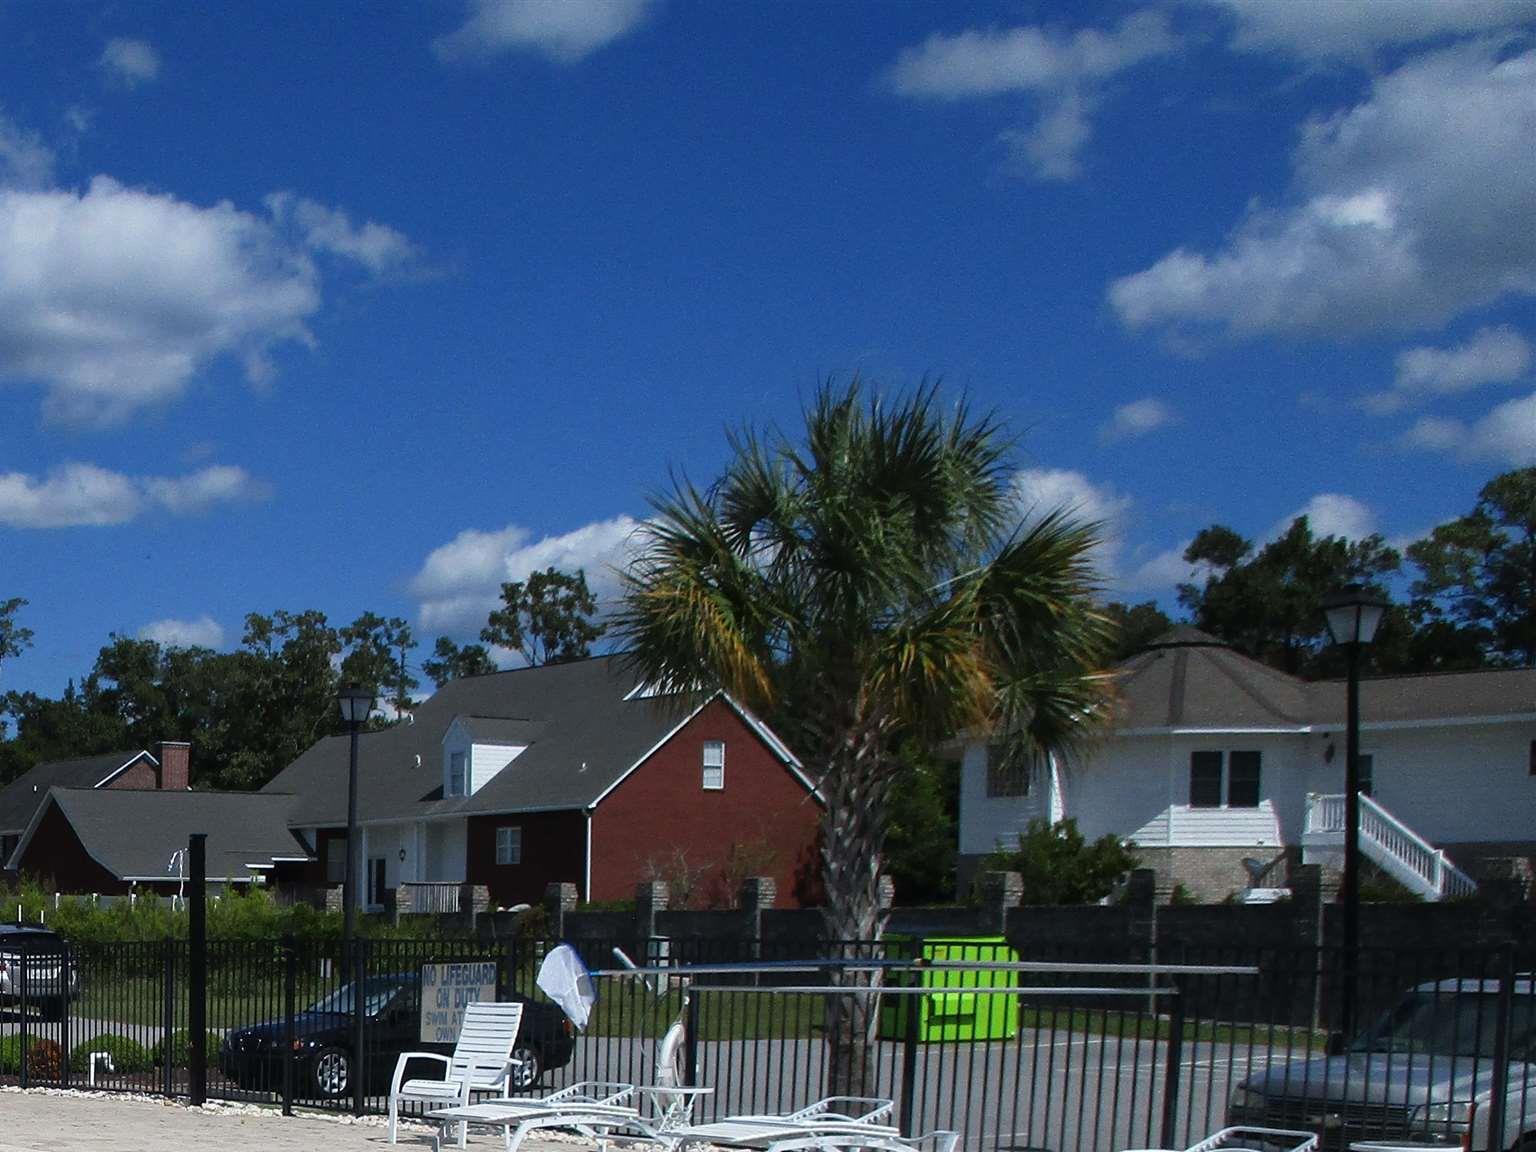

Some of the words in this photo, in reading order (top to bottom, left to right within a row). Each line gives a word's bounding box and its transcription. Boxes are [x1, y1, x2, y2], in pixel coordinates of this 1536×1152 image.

[423, 965, 436, 986] NO
[441, 963, 496, 986] LIFEGUARD
[436, 987, 449, 1008] ON
[454, 987, 481, 1008] DUTY
